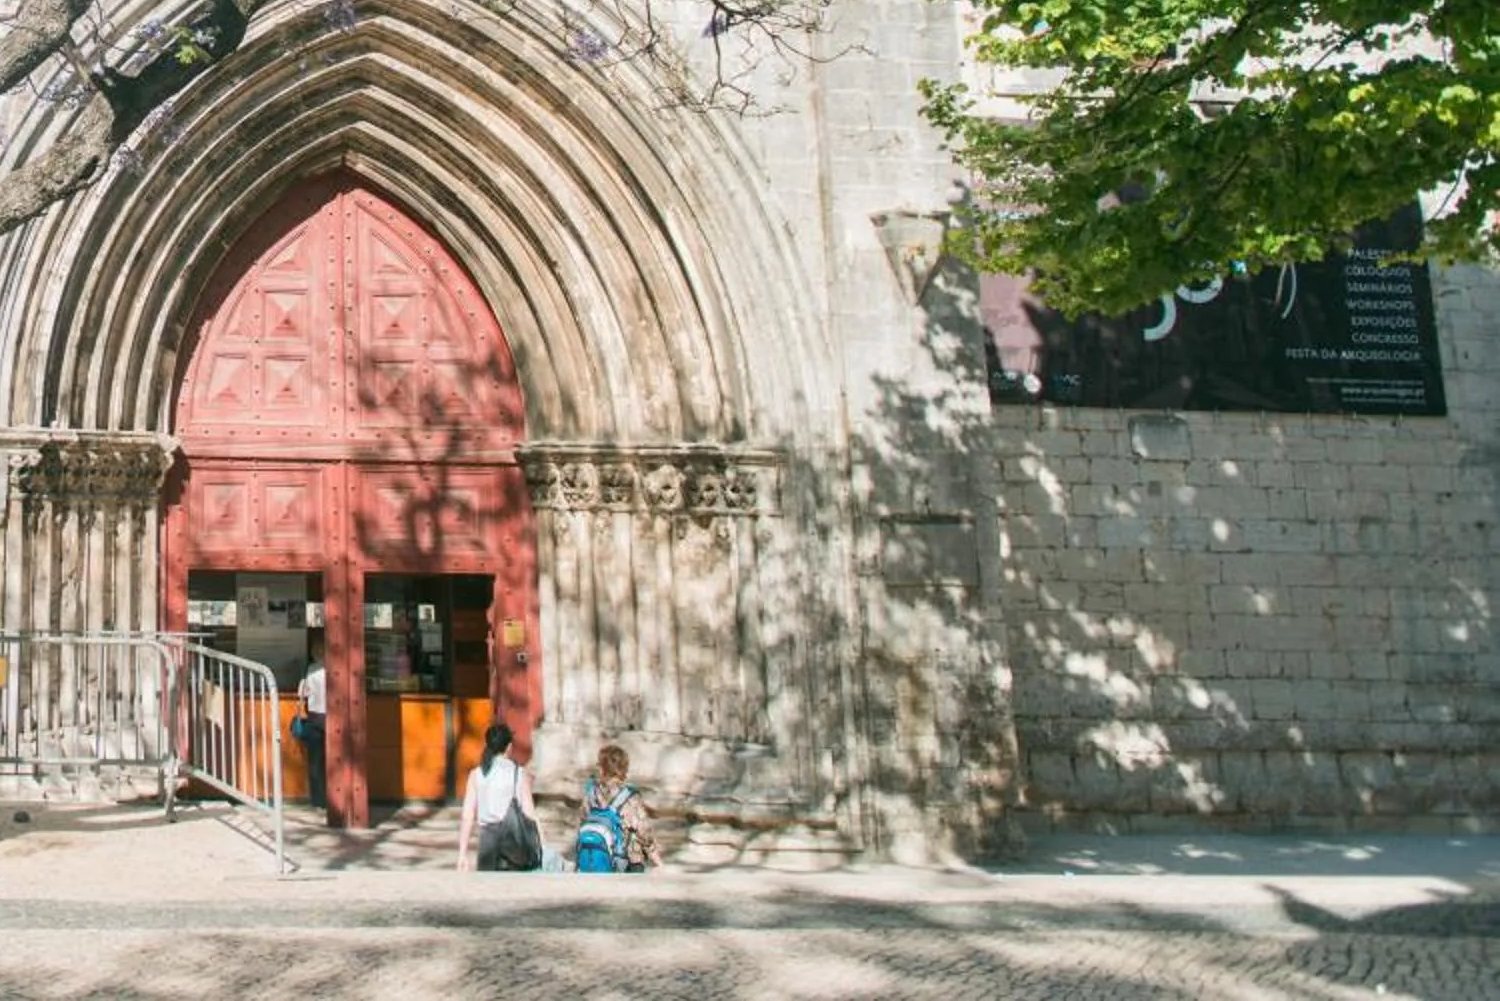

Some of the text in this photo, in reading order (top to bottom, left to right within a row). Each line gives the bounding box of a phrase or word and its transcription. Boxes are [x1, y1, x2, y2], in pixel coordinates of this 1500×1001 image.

[1351, 332, 1419, 344] CONGRESSO
[1285, 348, 1319, 359] FESTA
[1321, 349, 1338, 360] DA
